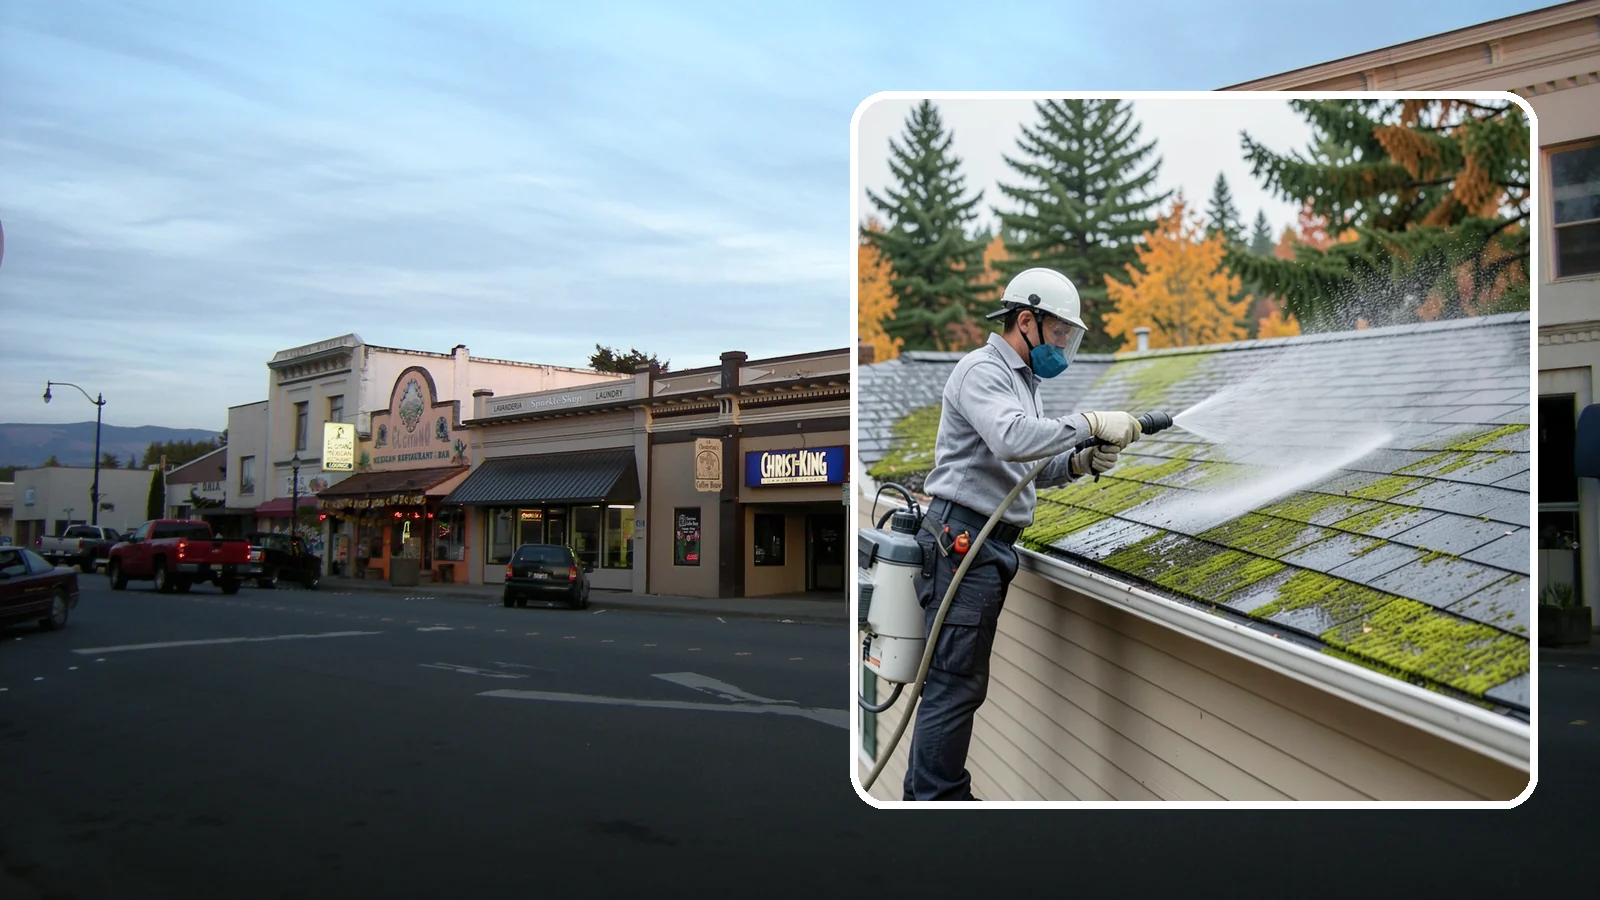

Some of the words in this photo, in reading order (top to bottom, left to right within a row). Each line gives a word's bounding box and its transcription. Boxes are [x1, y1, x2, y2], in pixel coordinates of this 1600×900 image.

[531, 397, 561, 409] Sparkle
[562, 394, 582, 405] Shop
[595, 389, 624, 400] LAUNDRY
[493, 402, 523, 412] LAVANDERIA
[373, 455, 397, 464] MEXICAN
[397, 451, 433, 462] RESTAURANT
[437, 450, 450, 458] BAR
[760, 452, 797, 478] CHRIST
[799, 450, 827, 476] KING
